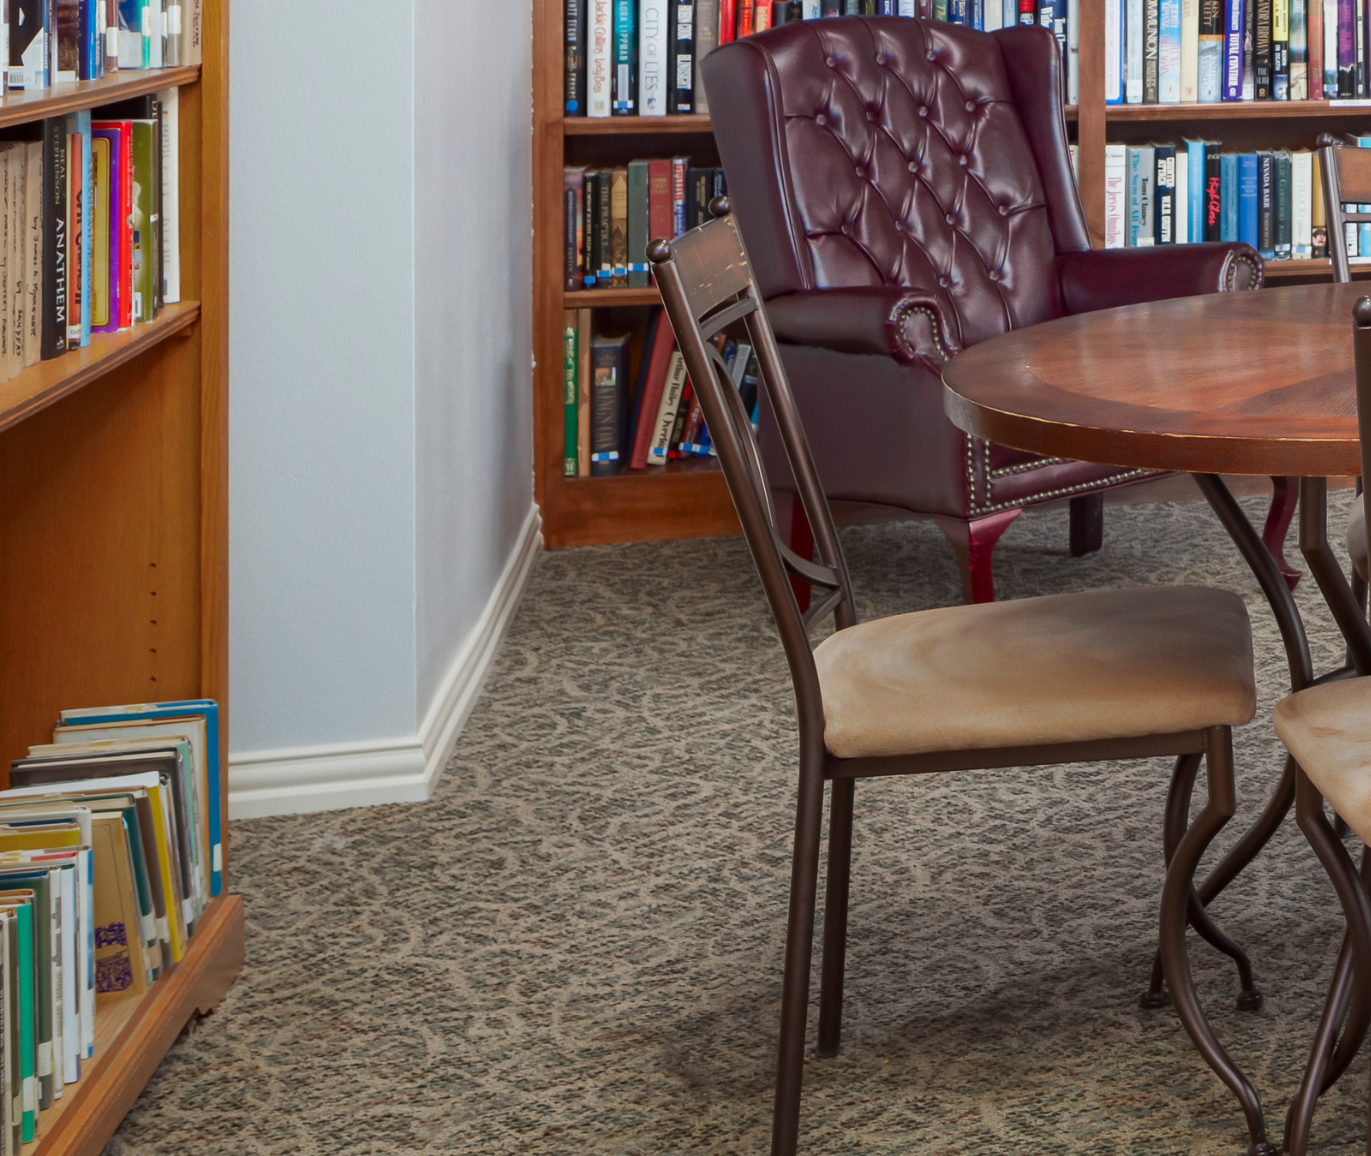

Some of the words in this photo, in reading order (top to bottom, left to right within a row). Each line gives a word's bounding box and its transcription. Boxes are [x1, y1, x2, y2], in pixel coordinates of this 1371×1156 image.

[645, 7, 659, 43] CITY
[594, 26, 607, 54] Collins
[619, 24, 628, 61] LIPPMAN
[647, 43, 657, 58] OF
[644, 60, 659, 91] LIES
[1206, 176, 1220, 201] High
[1208, 201, 1220, 226] Gloss
[56, 217, 65, 324] ANATHEM
